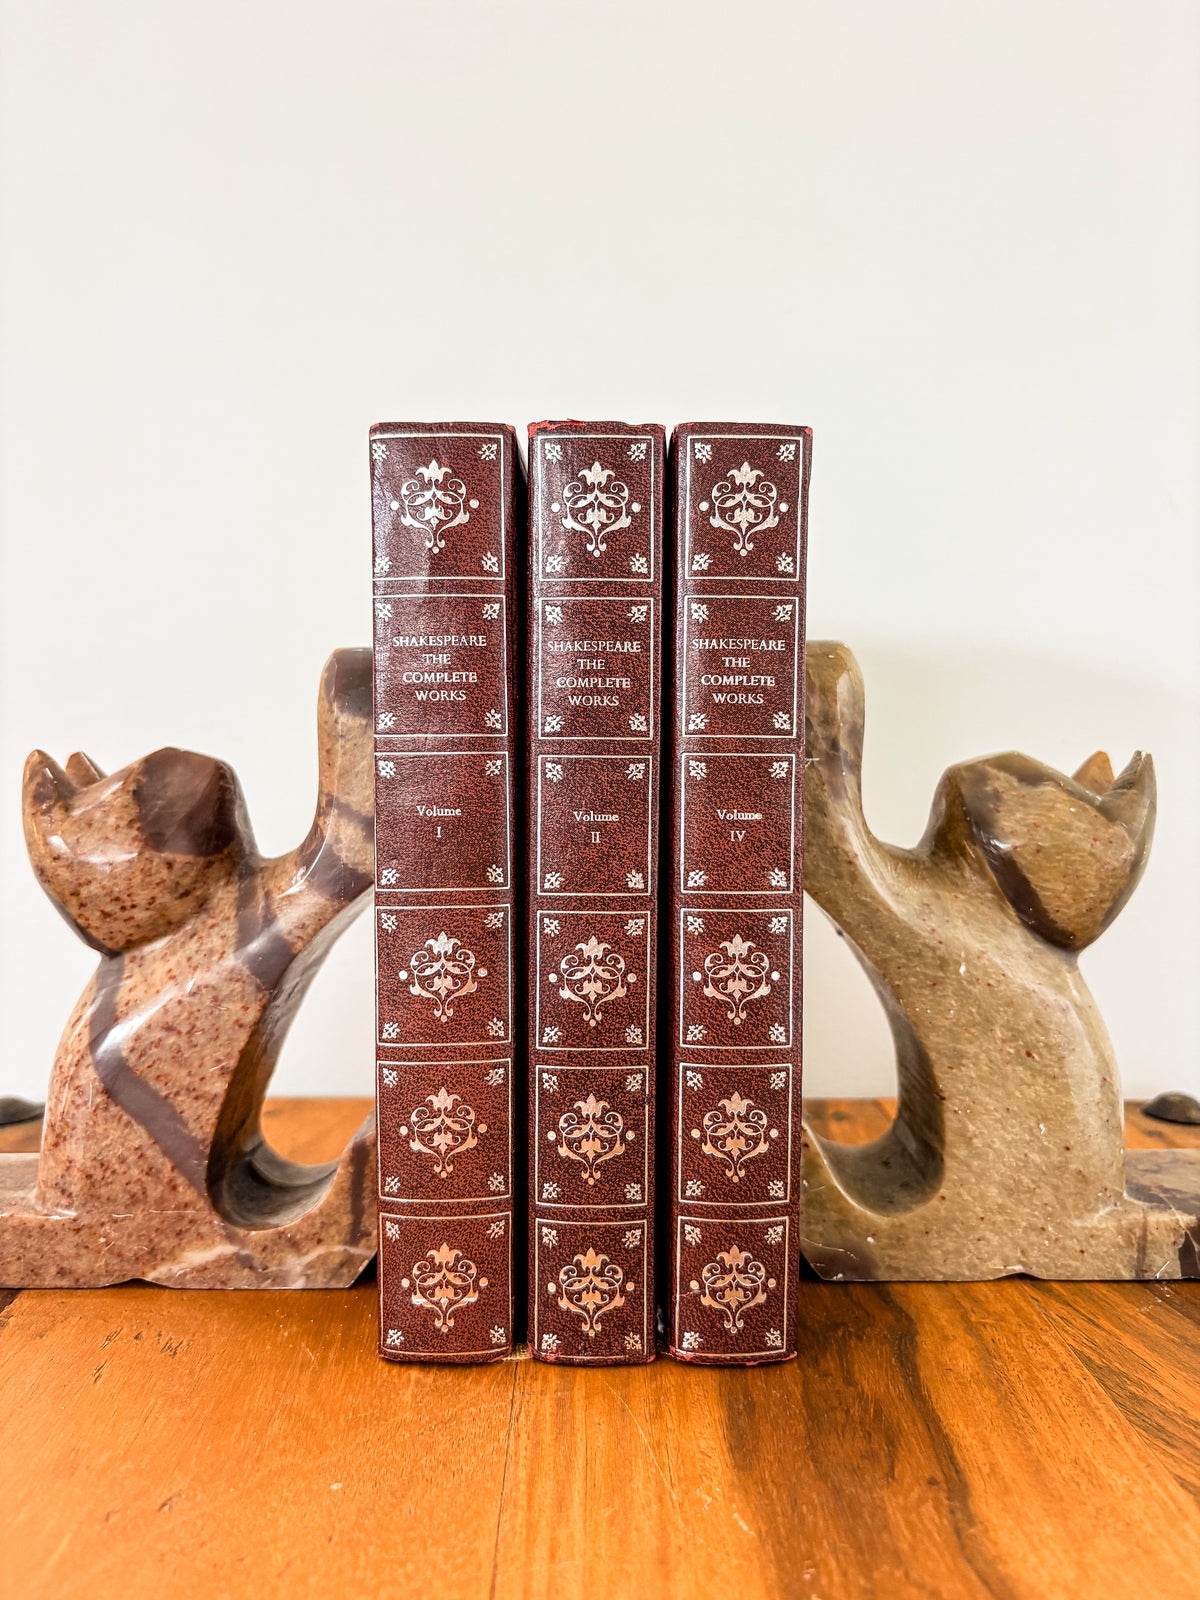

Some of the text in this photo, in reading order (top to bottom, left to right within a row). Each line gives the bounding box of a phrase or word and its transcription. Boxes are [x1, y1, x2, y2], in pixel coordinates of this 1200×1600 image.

[393, 636, 486, 646] SHAKESPEARE
[692, 639, 785, 650] SHAKESPEARE
[547, 641, 641, 652] SHAKESPEARE
[423, 654, 451, 664] THE
[577, 659, 605, 669] THE
[722, 657, 750, 667] THE
[403, 672, 477, 683] COMPLETE
[557, 677, 630, 688] COMPLETE
[701, 675, 775, 686] COMPLETE
[415, 691, 466, 701] WORKS
[568, 696, 619, 706] WORKS
[713, 693, 764, 704] WORKS
[416, 806, 461, 817] Volume
[573, 811, 619, 821] Volume
[716, 810, 762, 820] Volume
[437, 827, 441, 837] I
[730, 831, 746, 841] IV
[591, 832, 600, 843] II
